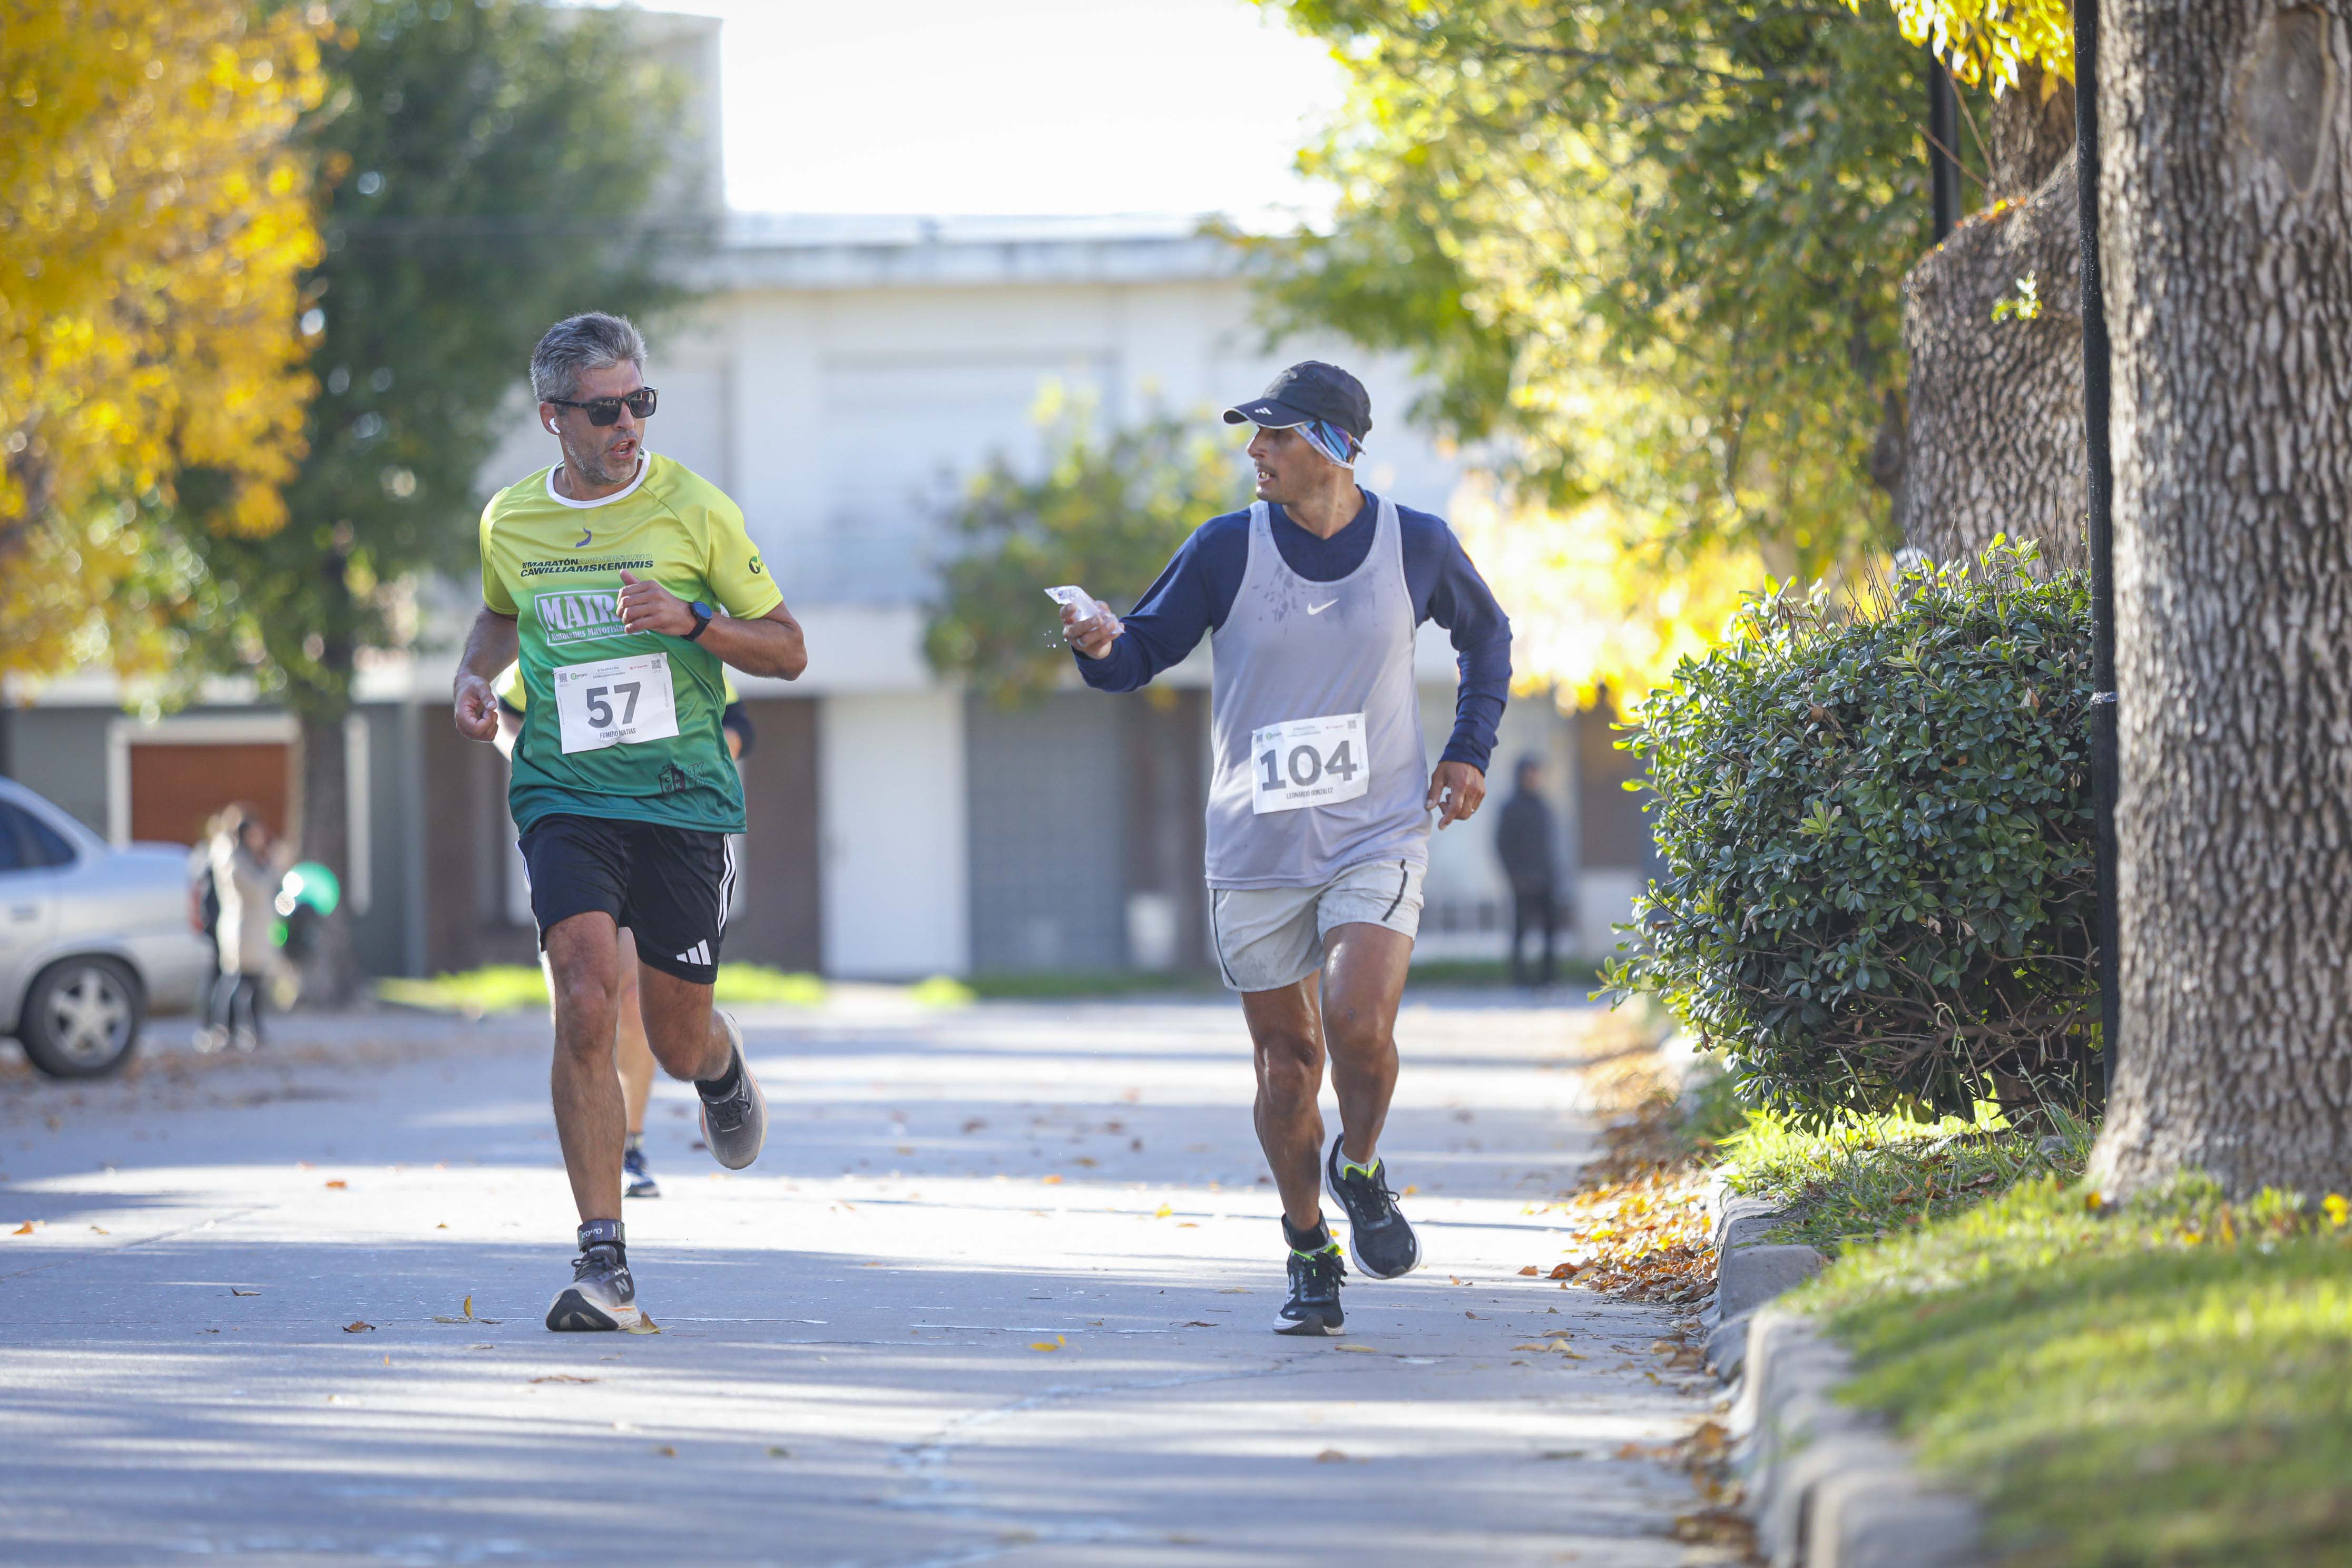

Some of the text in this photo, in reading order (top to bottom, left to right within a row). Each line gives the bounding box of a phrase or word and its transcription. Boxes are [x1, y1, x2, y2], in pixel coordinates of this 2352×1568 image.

[540, 595, 623, 631] MAIR
[586, 681, 641, 728] 57
[600, 728, 636, 739] FUMERO MATIAS
[1260, 740, 1358, 791] 104
[1287, 787, 1334, 799] LEONARDO GONZALEZ
